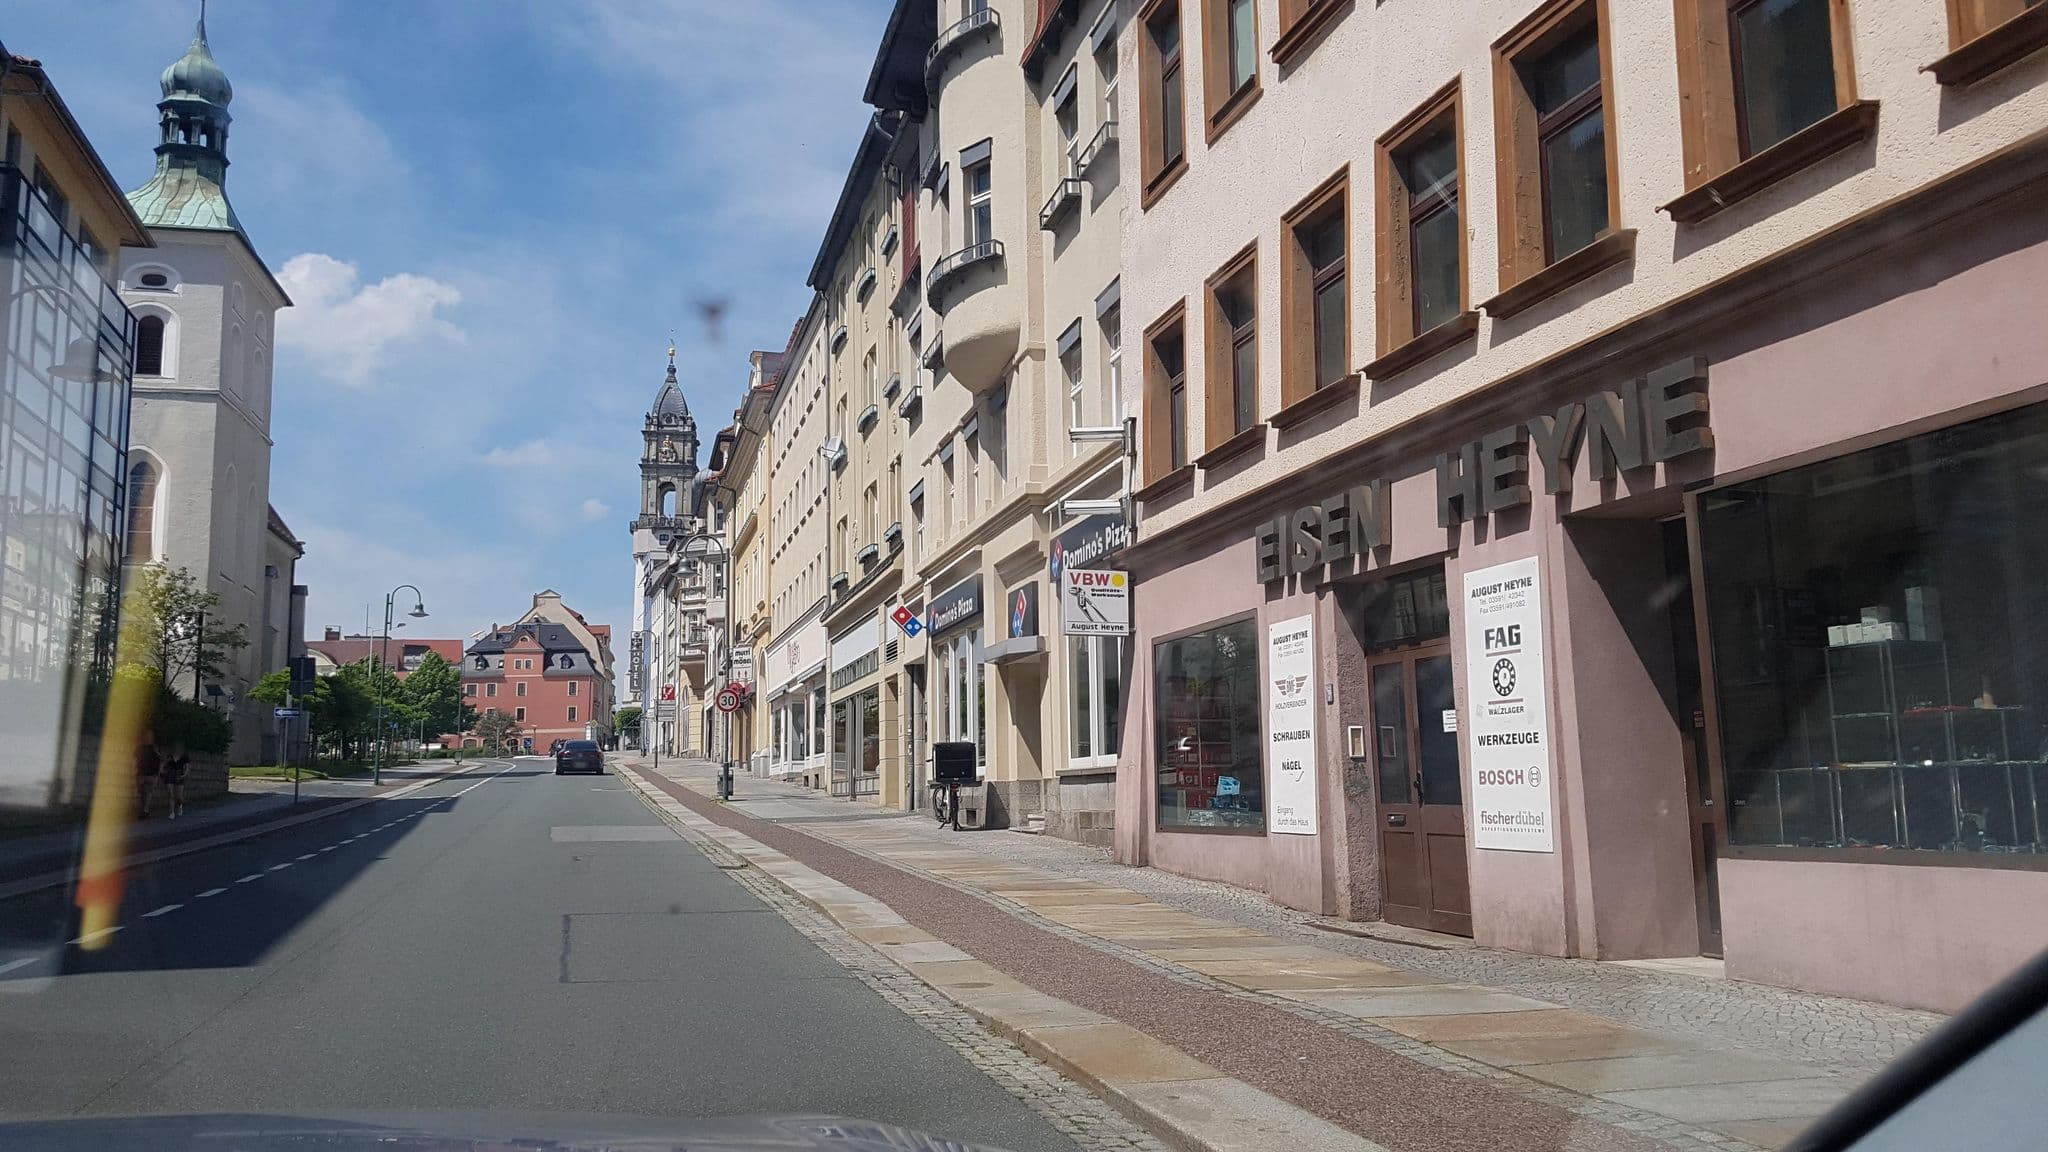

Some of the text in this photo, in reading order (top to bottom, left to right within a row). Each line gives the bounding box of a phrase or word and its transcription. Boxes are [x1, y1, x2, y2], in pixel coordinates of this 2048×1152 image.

[1256, 356, 1713, 584] EISEN HEYNE
[1062, 522, 1128, 569] Domino's Pizz
[1069, 572, 1110, 586] VBW
[1471, 576, 1533, 599] AUGUST HEYNE
[1071, 623, 1124, 631] August Heyne
[1273, 634, 1291, 646] AUGUST
[1292, 630, 1308, 641] HEYNE
[1484, 624, 1521, 650] FAG
[721, 695, 735, 707] 30
[1273, 730, 1311, 742] SCHRAUBEN
[1478, 732, 1539, 747] WERKZEUGE
[1479, 769, 1524, 786] BOSCH
[1480, 811, 1545, 827] fischerdübel
